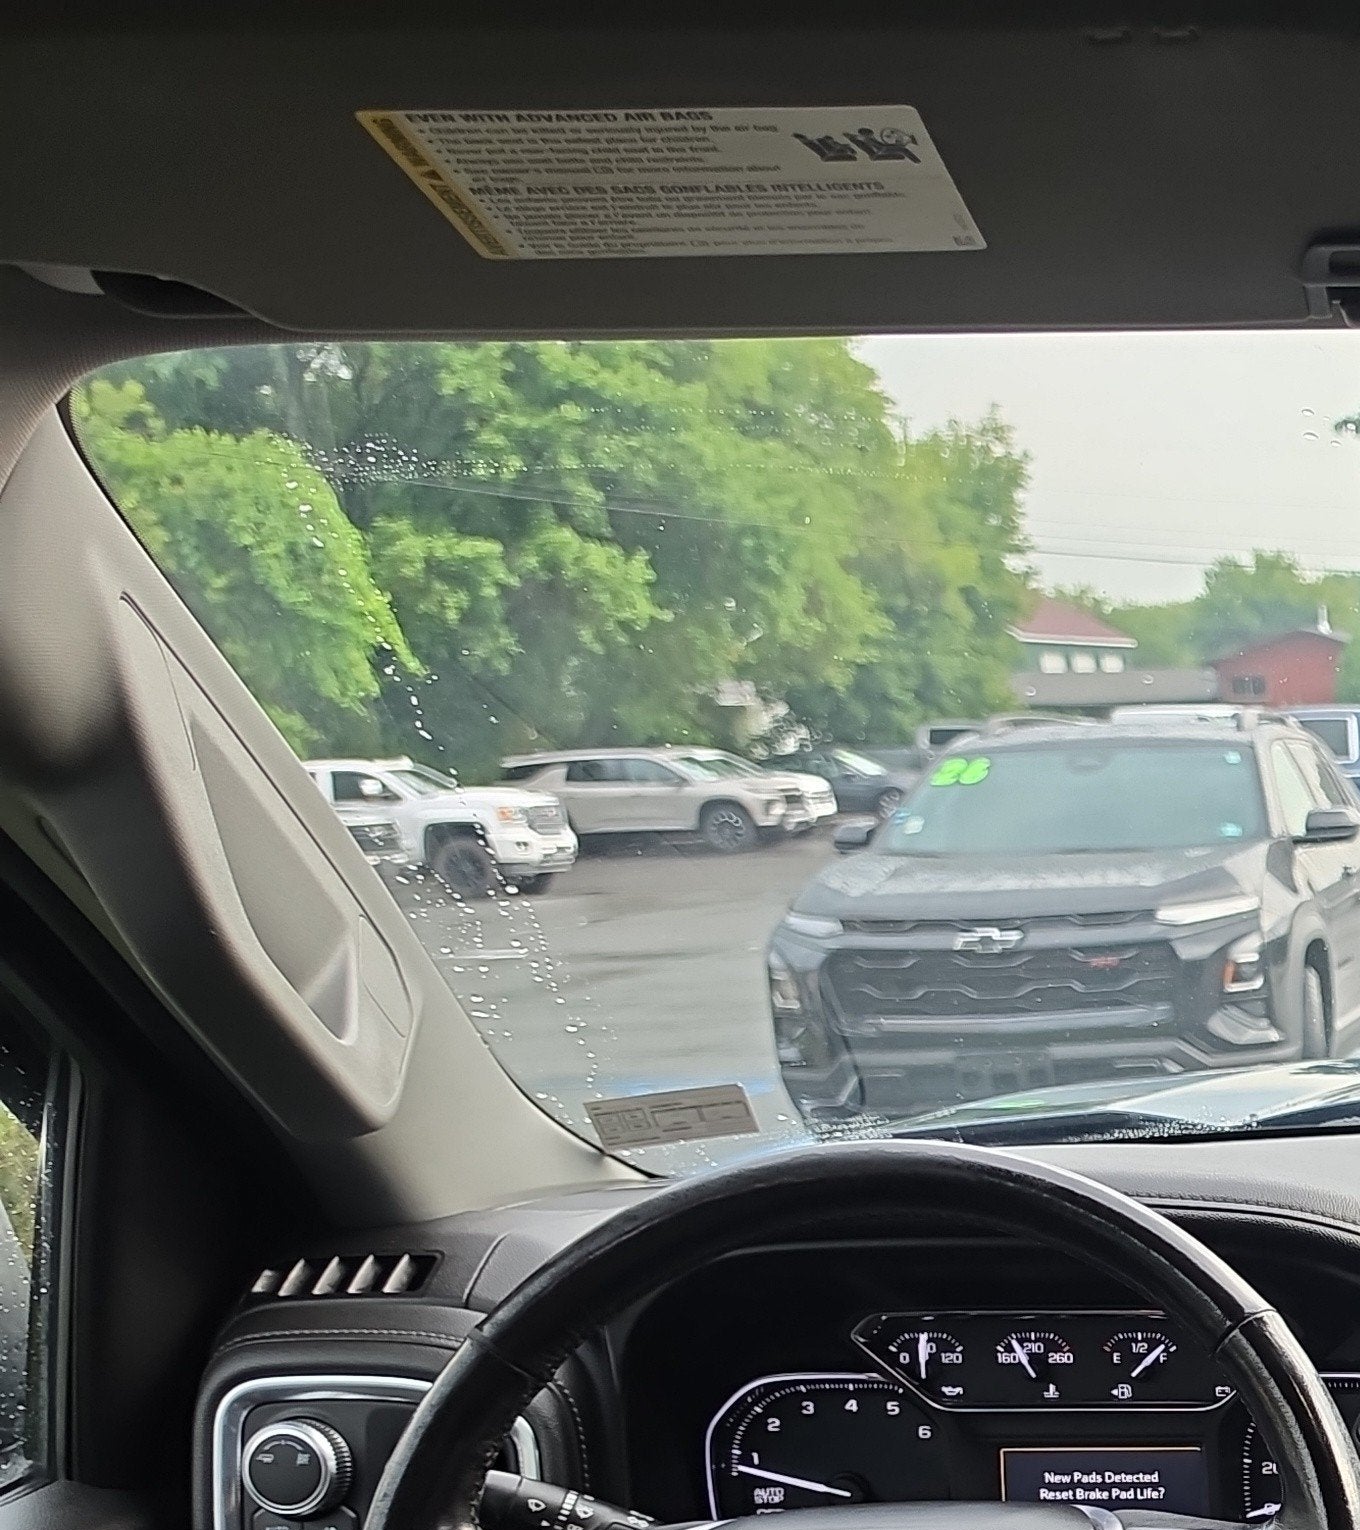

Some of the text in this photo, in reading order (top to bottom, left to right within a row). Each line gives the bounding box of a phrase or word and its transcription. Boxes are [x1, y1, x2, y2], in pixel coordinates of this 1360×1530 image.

[515, 112, 618, 123] ADVANCED
[624, 111, 657, 122] AIR
[660, 111, 713, 121] BAGS
[1023, 1342, 1044, 1353] 210
[1131, 1342, 1148, 1353] 1/2
[899, 1353, 910, 1363] 0
[941, 1353, 963, 1364] 120
[997, 1353, 1019, 1364] 160
[1048, 1353, 1074, 1364] 260
[1113, 1353, 1121, 1364] E
[1159, 1353, 1168, 1364] F
[801, 1401, 815, 1415] 3
[844, 1399, 859, 1413] 4
[886, 1401, 900, 1416] 5
[766, 1417, 781, 1432] 2
[918, 1425, 932, 1439] 6
[751, 1452, 760, 1466] 1
[1043, 1471, 1160, 1483] New Pads Detected
[753, 1487, 785, 1496] AUTO
[1040, 1487, 1166, 1500] Reset Brake Pad Life?
[753, 1496, 785, 1504] STOP
